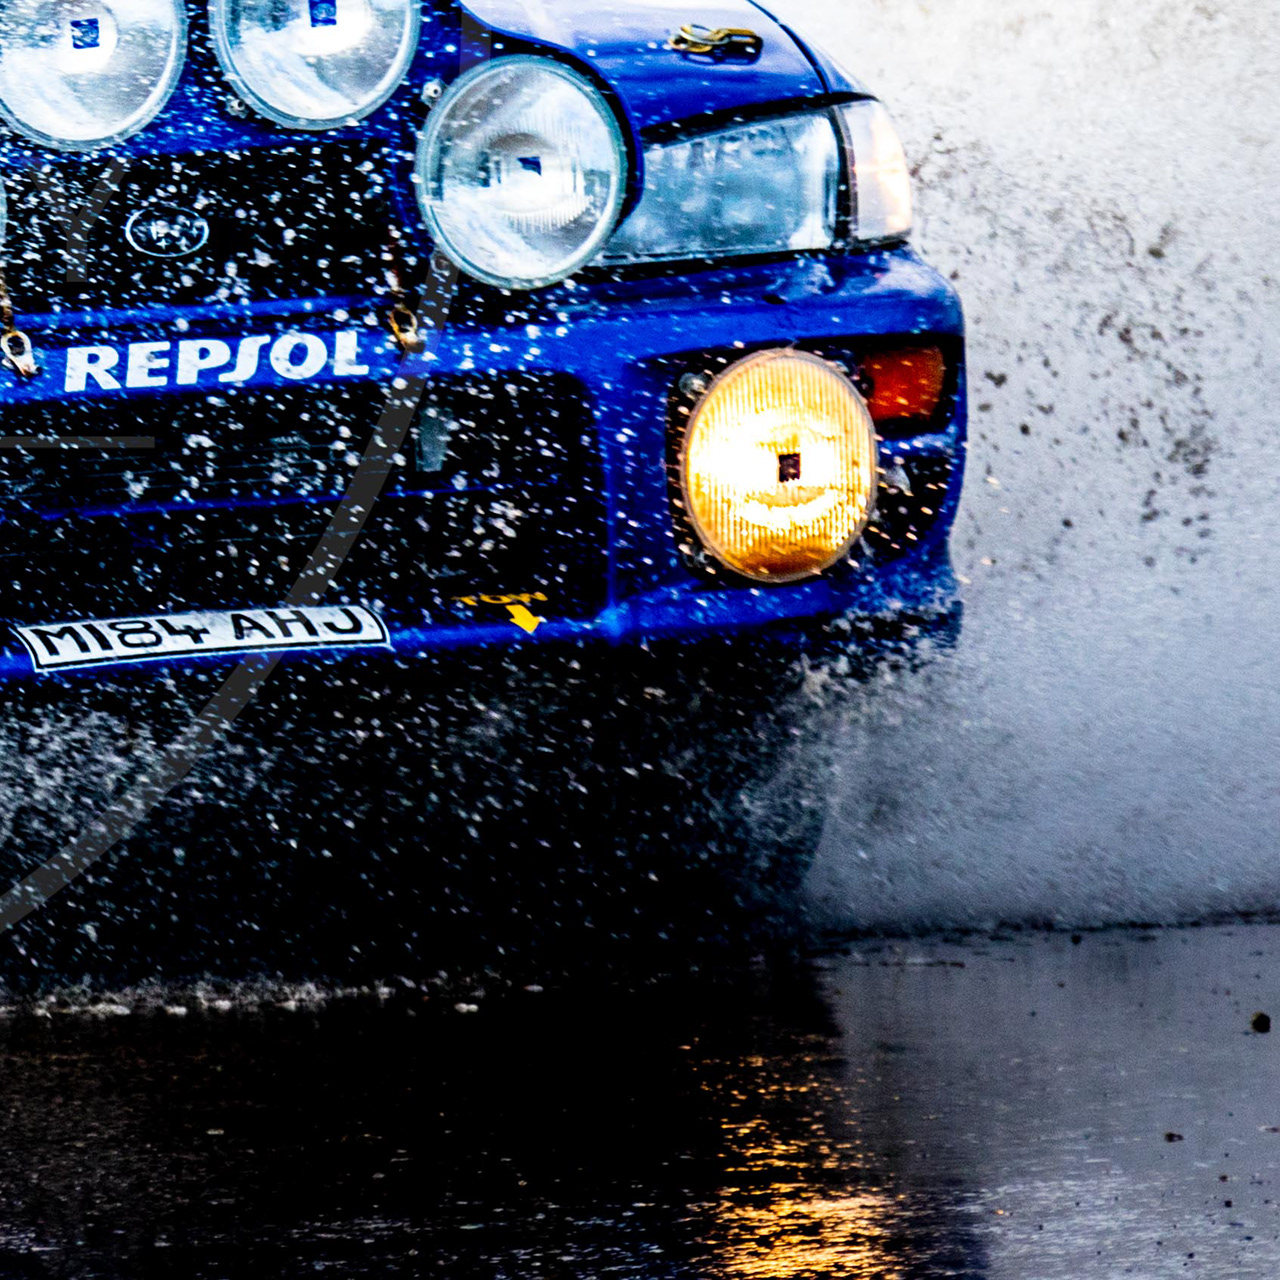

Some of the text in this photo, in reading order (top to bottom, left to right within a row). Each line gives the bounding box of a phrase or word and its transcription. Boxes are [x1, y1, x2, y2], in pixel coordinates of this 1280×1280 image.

[63, 328, 370, 394] REPSOL
[30, 606, 365, 658] M184 AHJ
